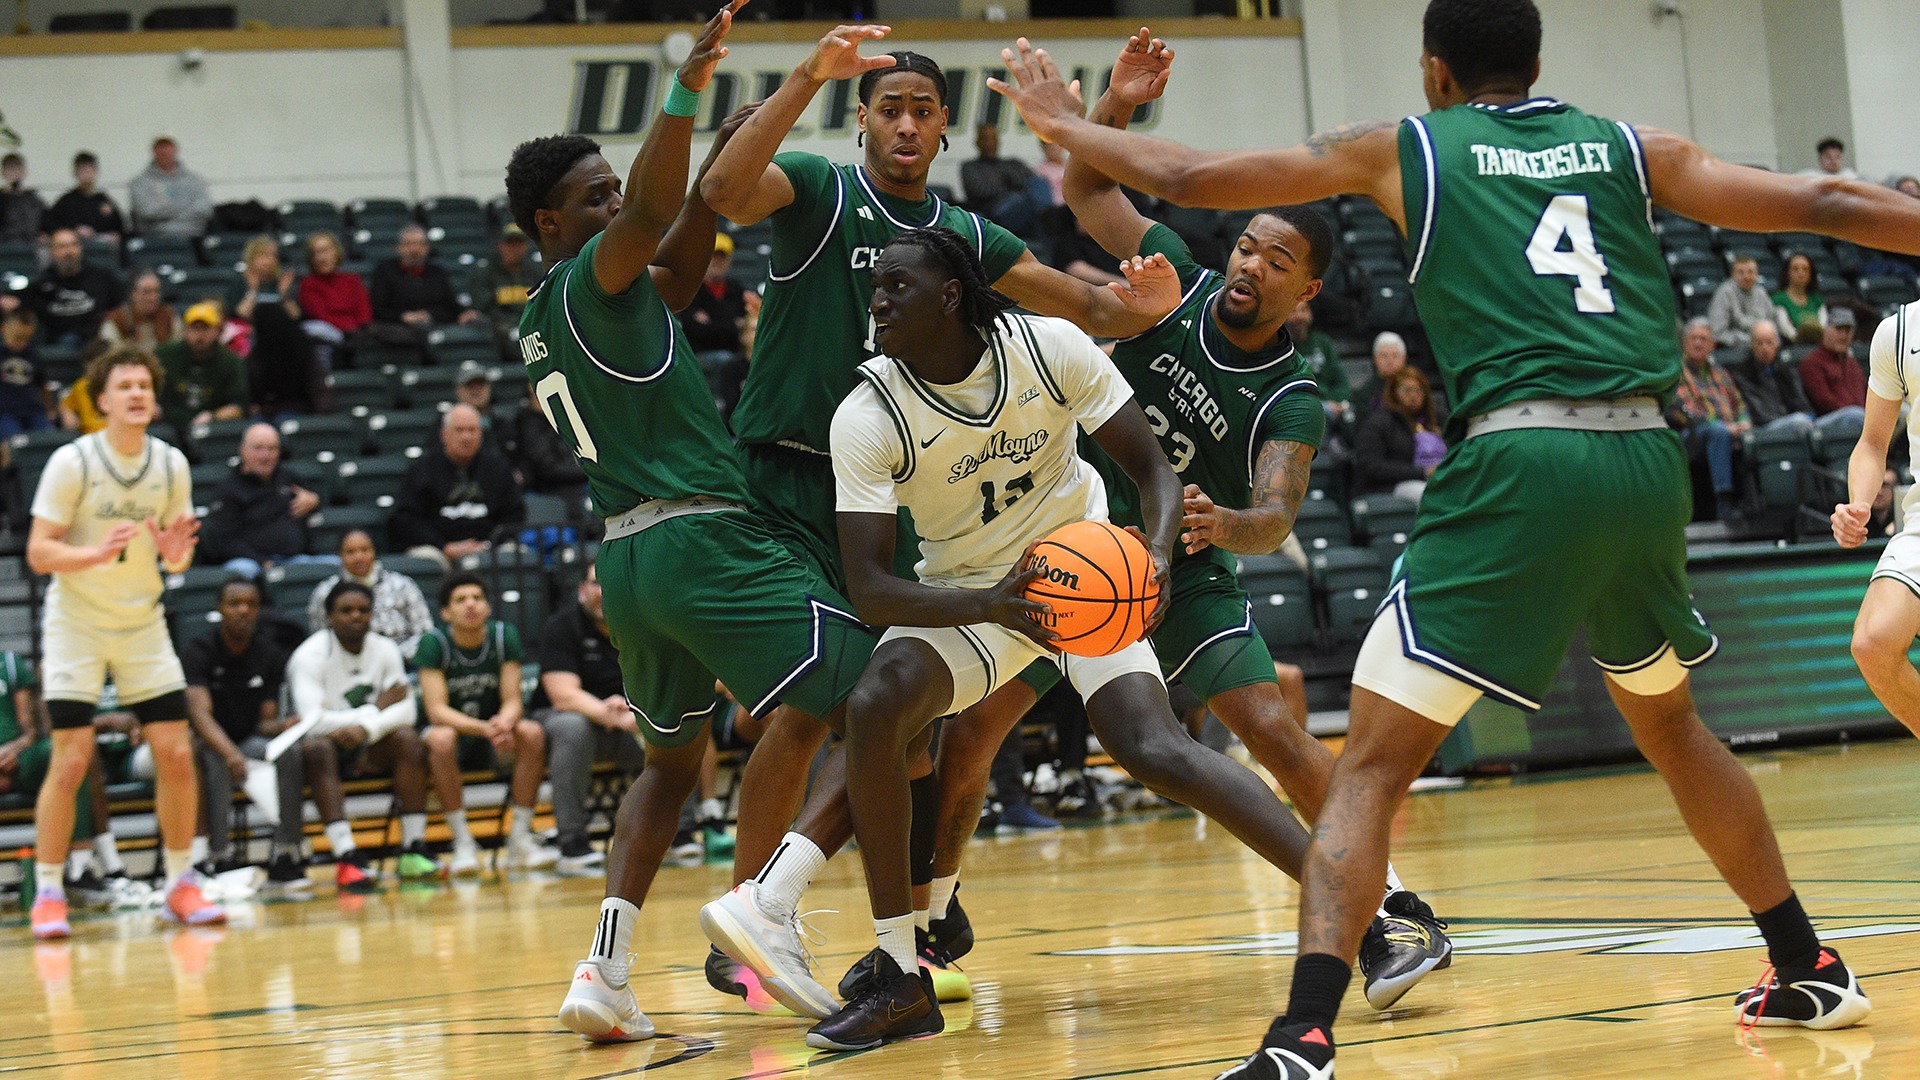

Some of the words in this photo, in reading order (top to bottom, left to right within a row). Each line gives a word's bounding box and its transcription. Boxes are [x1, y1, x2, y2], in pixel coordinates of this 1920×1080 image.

[1470, 142, 1612, 179] TANKERSLEY
[1525, 195, 1616, 313] 4
[1149, 353, 1229, 442] CHICAGO
[978, 429, 1049, 464] Moyne
[1144, 404, 1196, 473] 23
